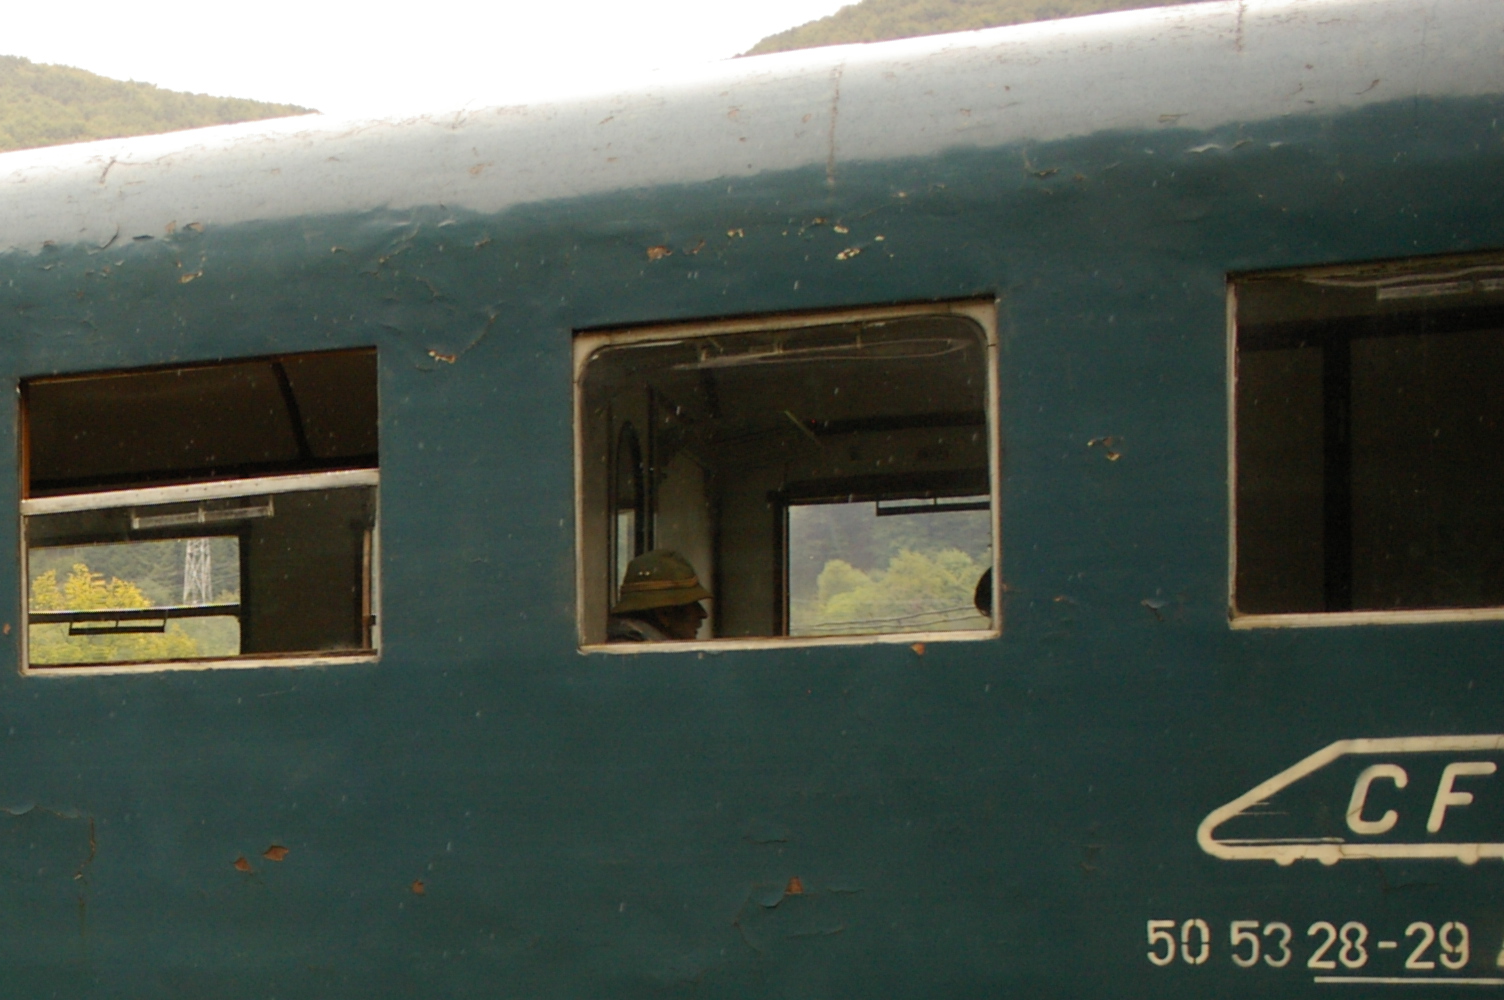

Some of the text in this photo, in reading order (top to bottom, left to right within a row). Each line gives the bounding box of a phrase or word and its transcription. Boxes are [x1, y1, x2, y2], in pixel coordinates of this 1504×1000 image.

[1147, 918, 1470, 970] 50 53 28-29
